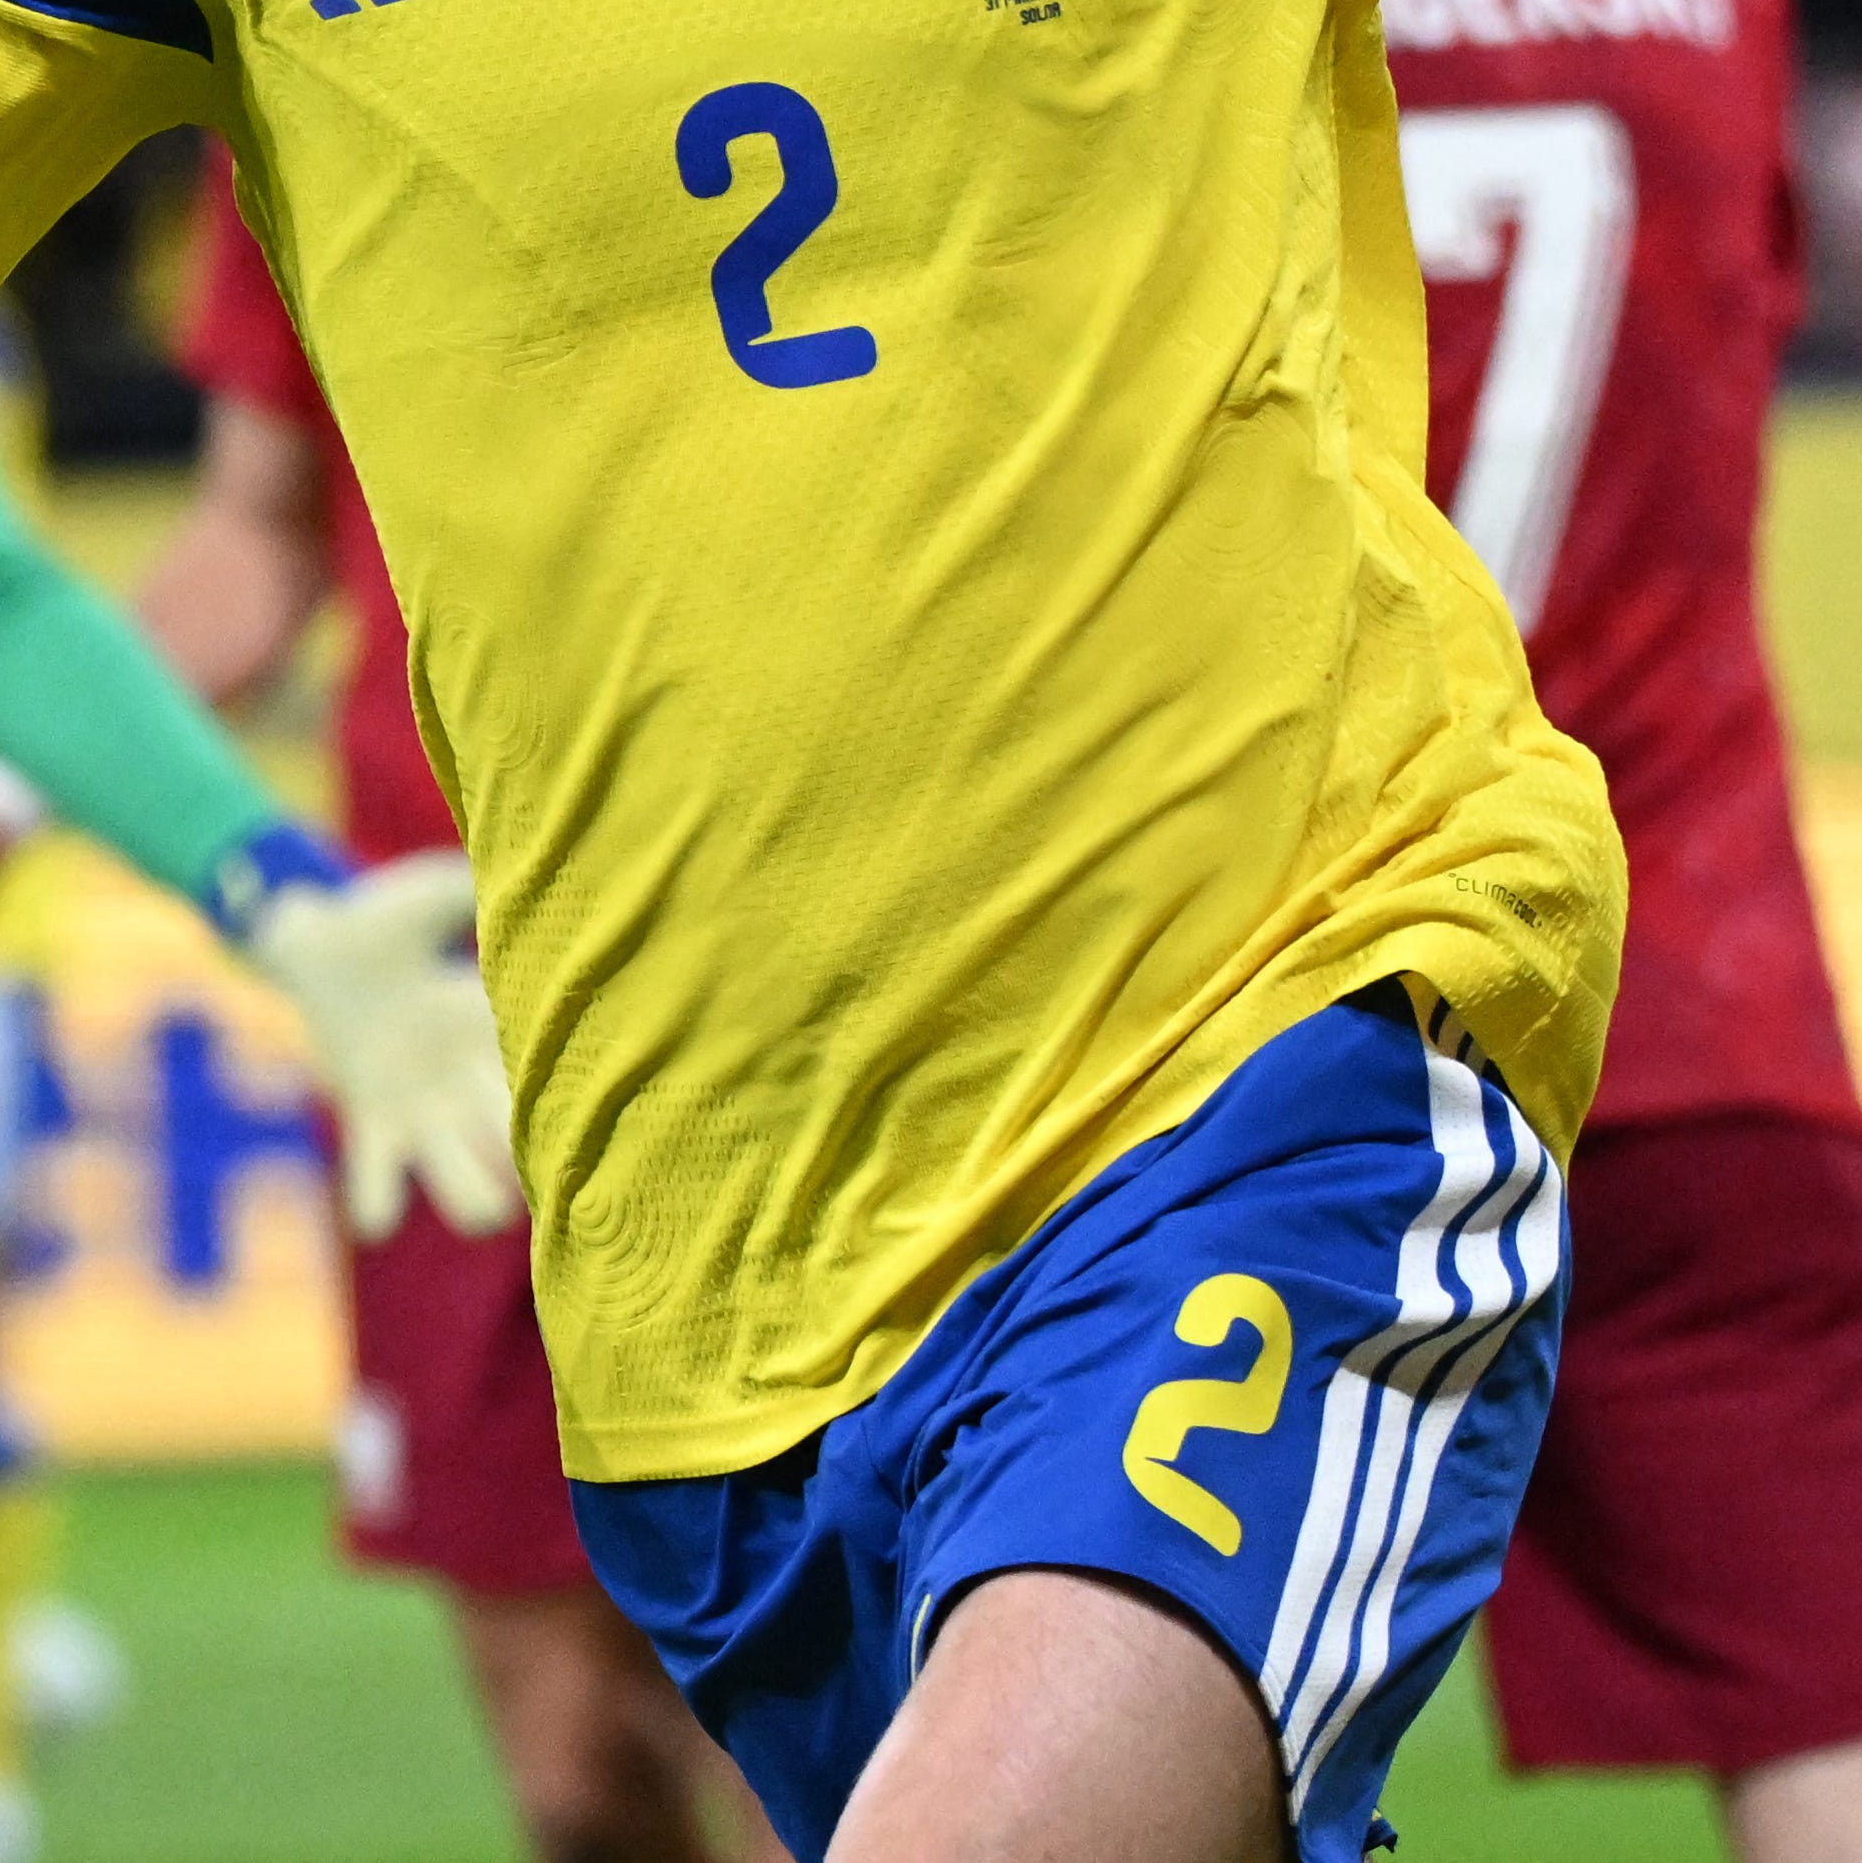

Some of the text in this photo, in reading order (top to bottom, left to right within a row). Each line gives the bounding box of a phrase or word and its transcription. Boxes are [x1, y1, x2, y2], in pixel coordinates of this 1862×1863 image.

[1020, 1, 1062, 26] SOLNA
[675, 81, 878, 390] 2
[1122, 1272, 1293, 1557] 2
